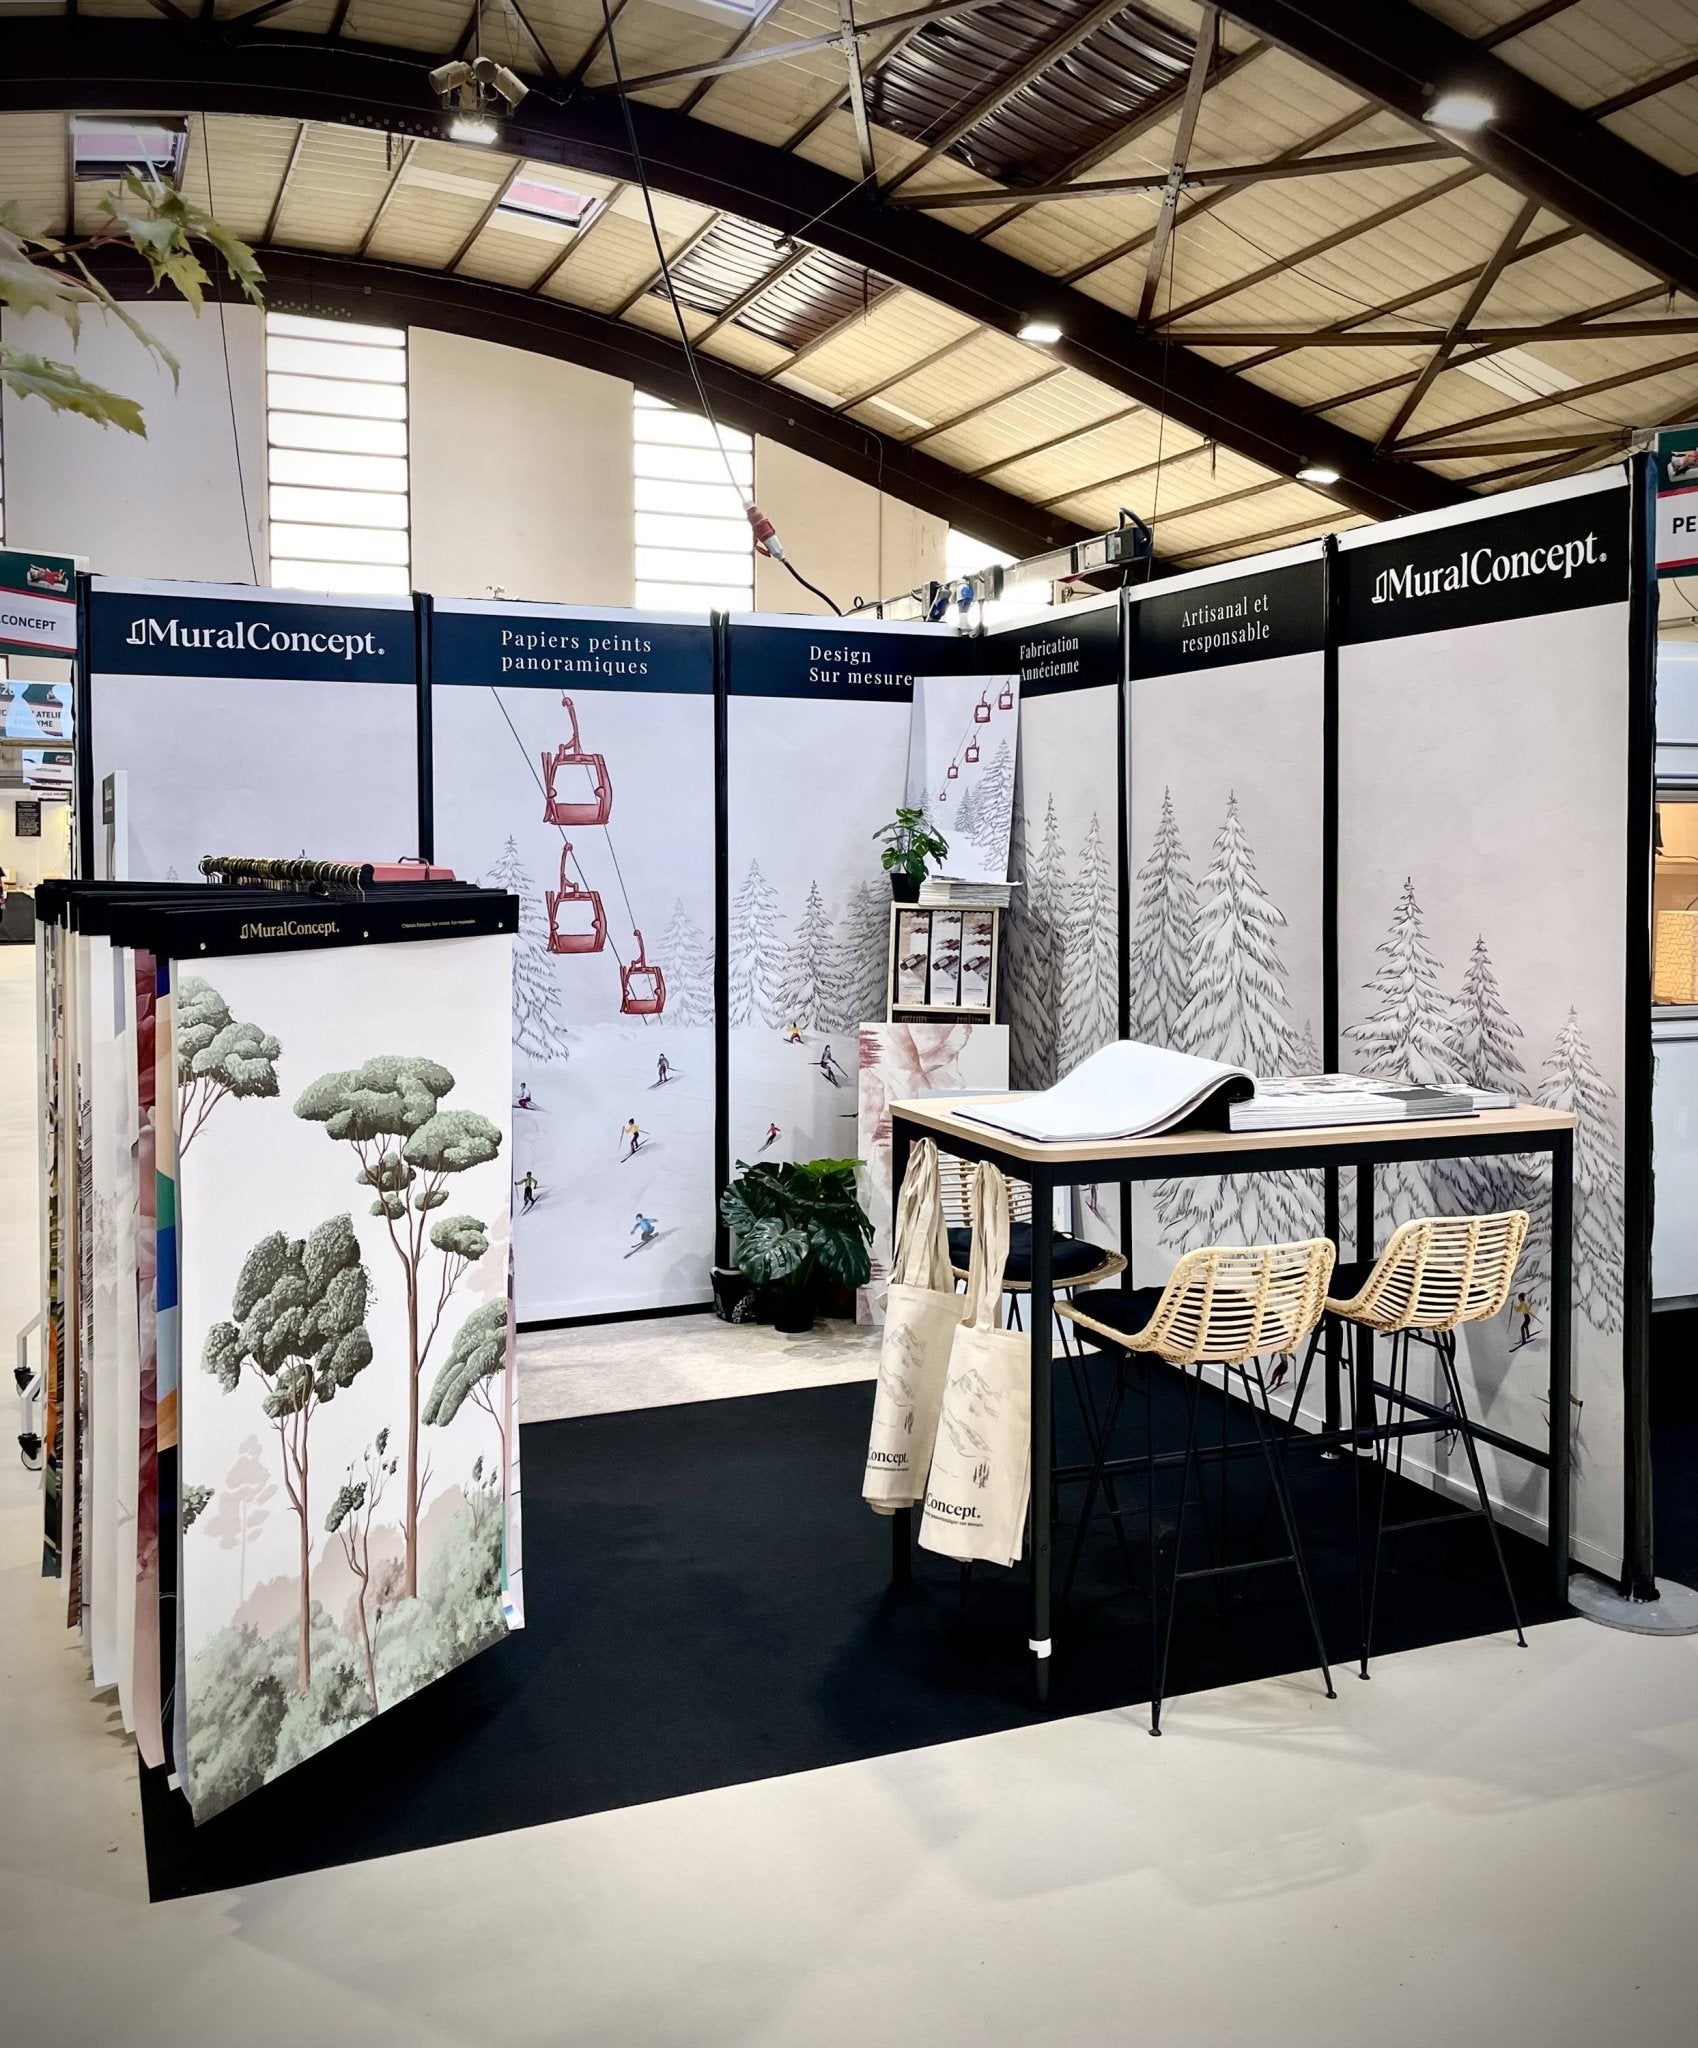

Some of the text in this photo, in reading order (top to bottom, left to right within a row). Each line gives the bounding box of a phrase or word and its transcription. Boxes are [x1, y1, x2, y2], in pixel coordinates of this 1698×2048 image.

[1181, 593, 1269, 628] Artisanal et
[0, 614, 57, 631] CONCEPT
[501, 630, 652, 653] Papiers peints
[1182, 620, 1270, 653] responsable
[809, 645, 872, 666] Design
[1019, 635, 1079, 661] Fabrication
[501, 656, 649, 677] panoramiques
[809, 666, 913, 686] Sur mesure
[1020, 660, 1080, 682] Annécienne
